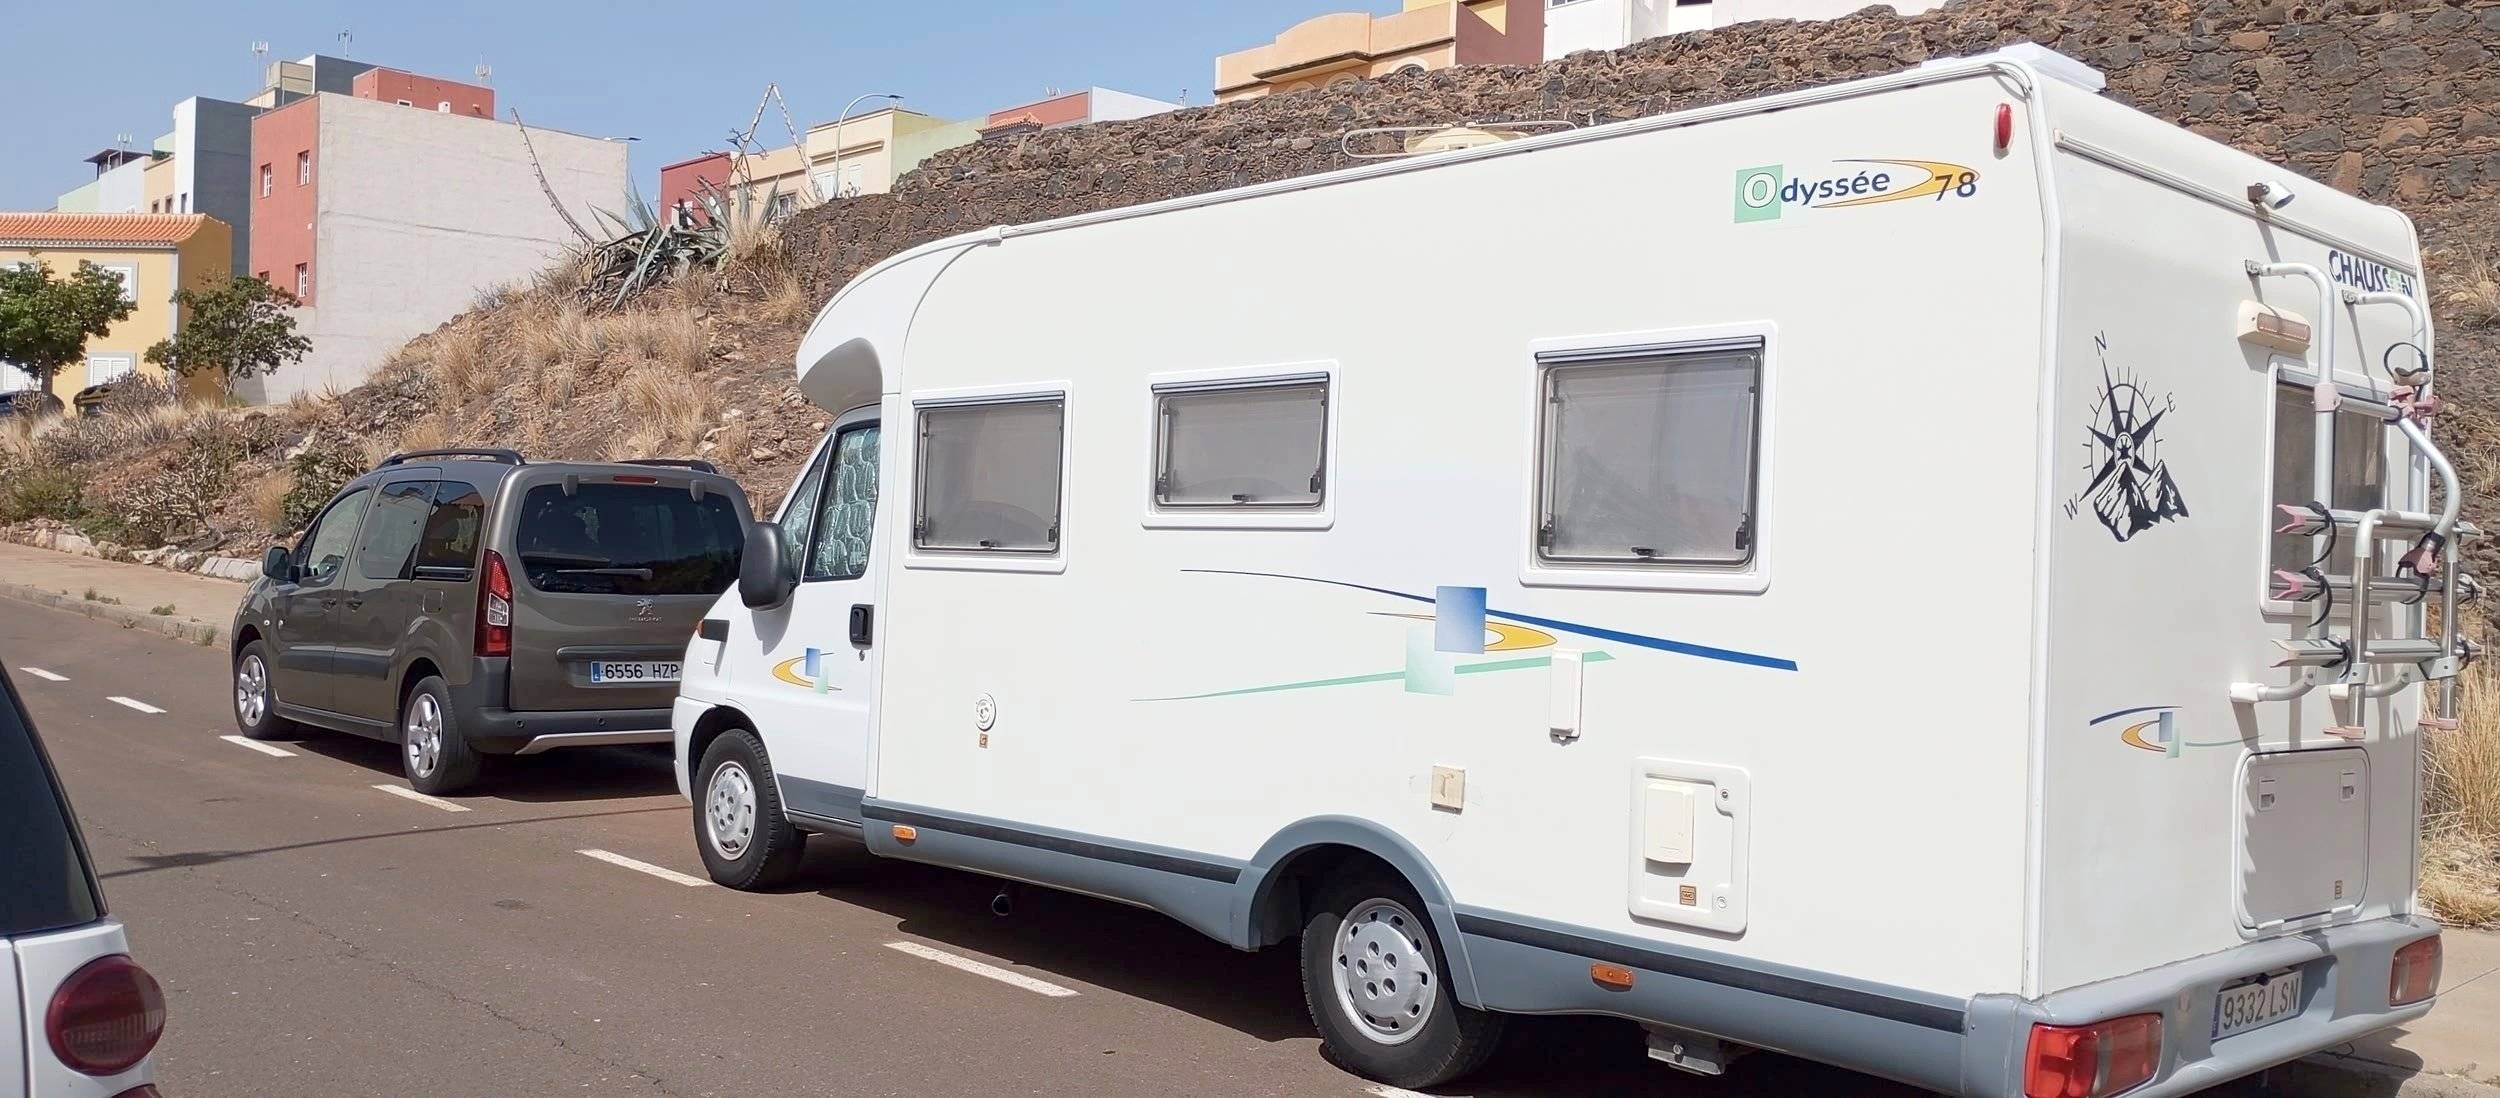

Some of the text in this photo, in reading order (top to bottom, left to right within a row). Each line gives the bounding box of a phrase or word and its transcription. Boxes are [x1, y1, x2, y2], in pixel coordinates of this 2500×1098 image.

[1742, 170, 1977, 209] Odyssée 78
[2094, 329, 2107, 356] N
[2166, 391, 2177, 413] E
[2063, 493, 2080, 520] W
[605, 663, 643, 679] 6556
[652, 663, 679, 679] HZP
[2223, 977, 2299, 1030] 9332 LSN
